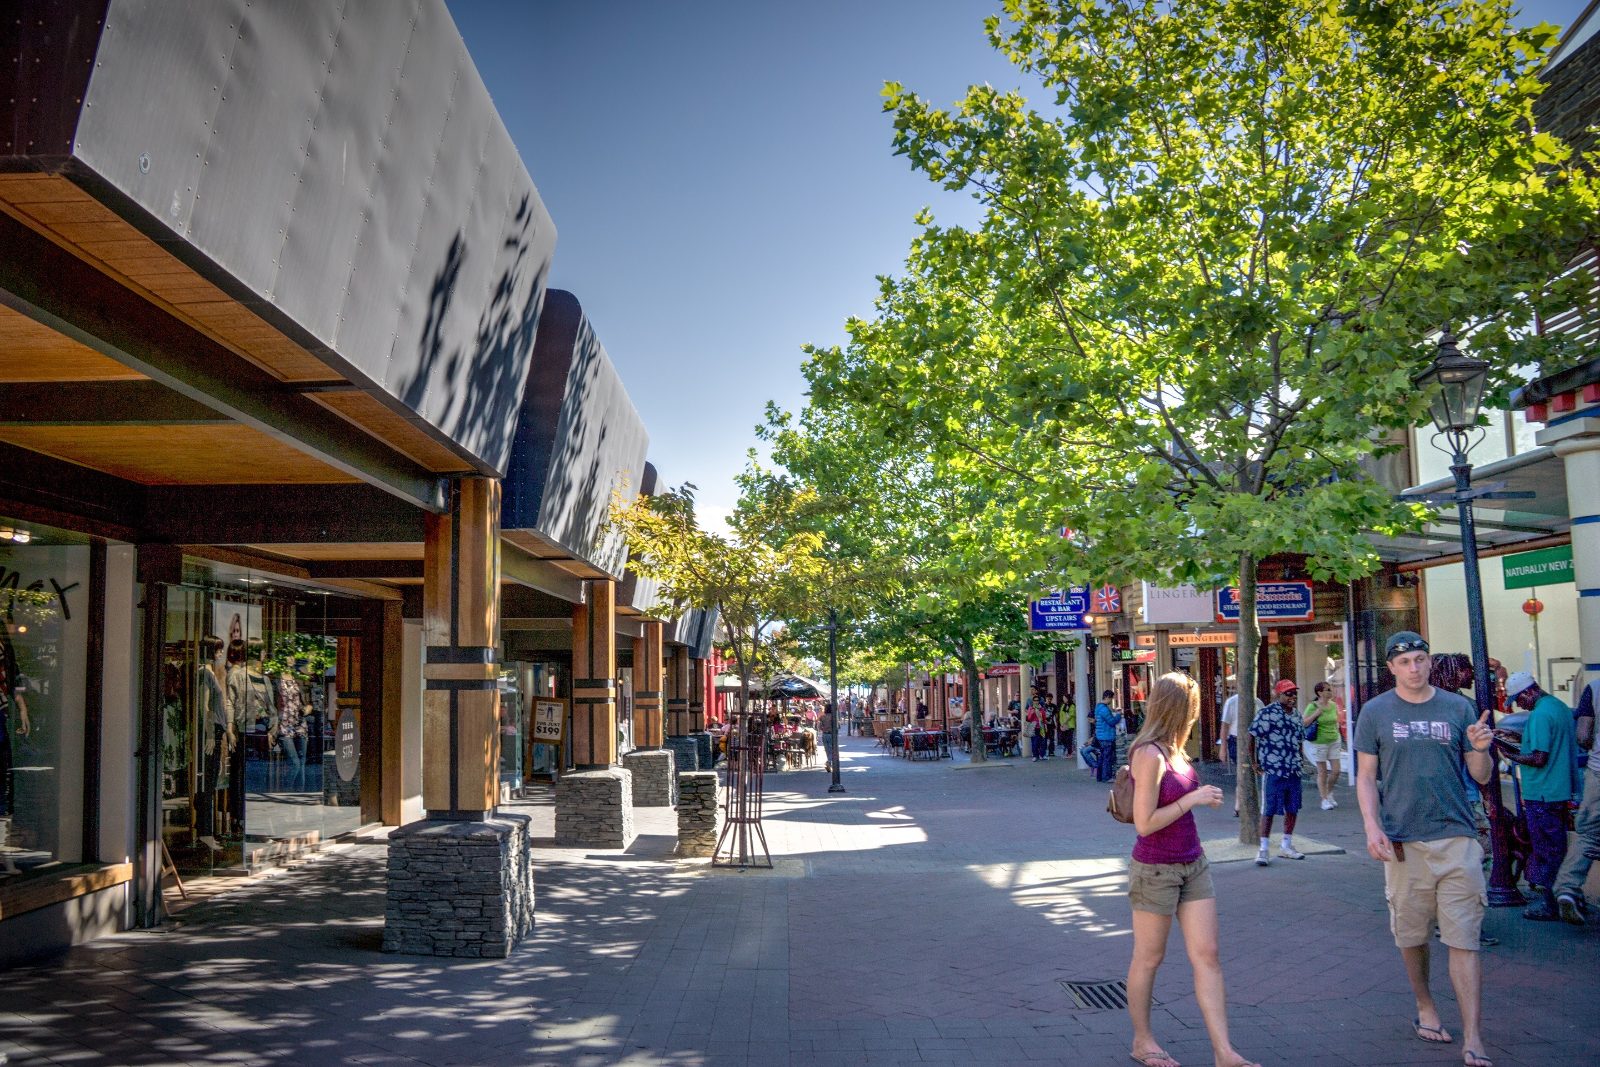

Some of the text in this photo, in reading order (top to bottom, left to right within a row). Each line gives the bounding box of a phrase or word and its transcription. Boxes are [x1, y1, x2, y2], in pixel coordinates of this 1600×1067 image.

[1505, 563, 1548, 577] NATURALLY
[1549, 560, 1567, 571] NEW
[1186, 634, 1228, 643] LINGERIE
[536, 726, 560, 735] $199
